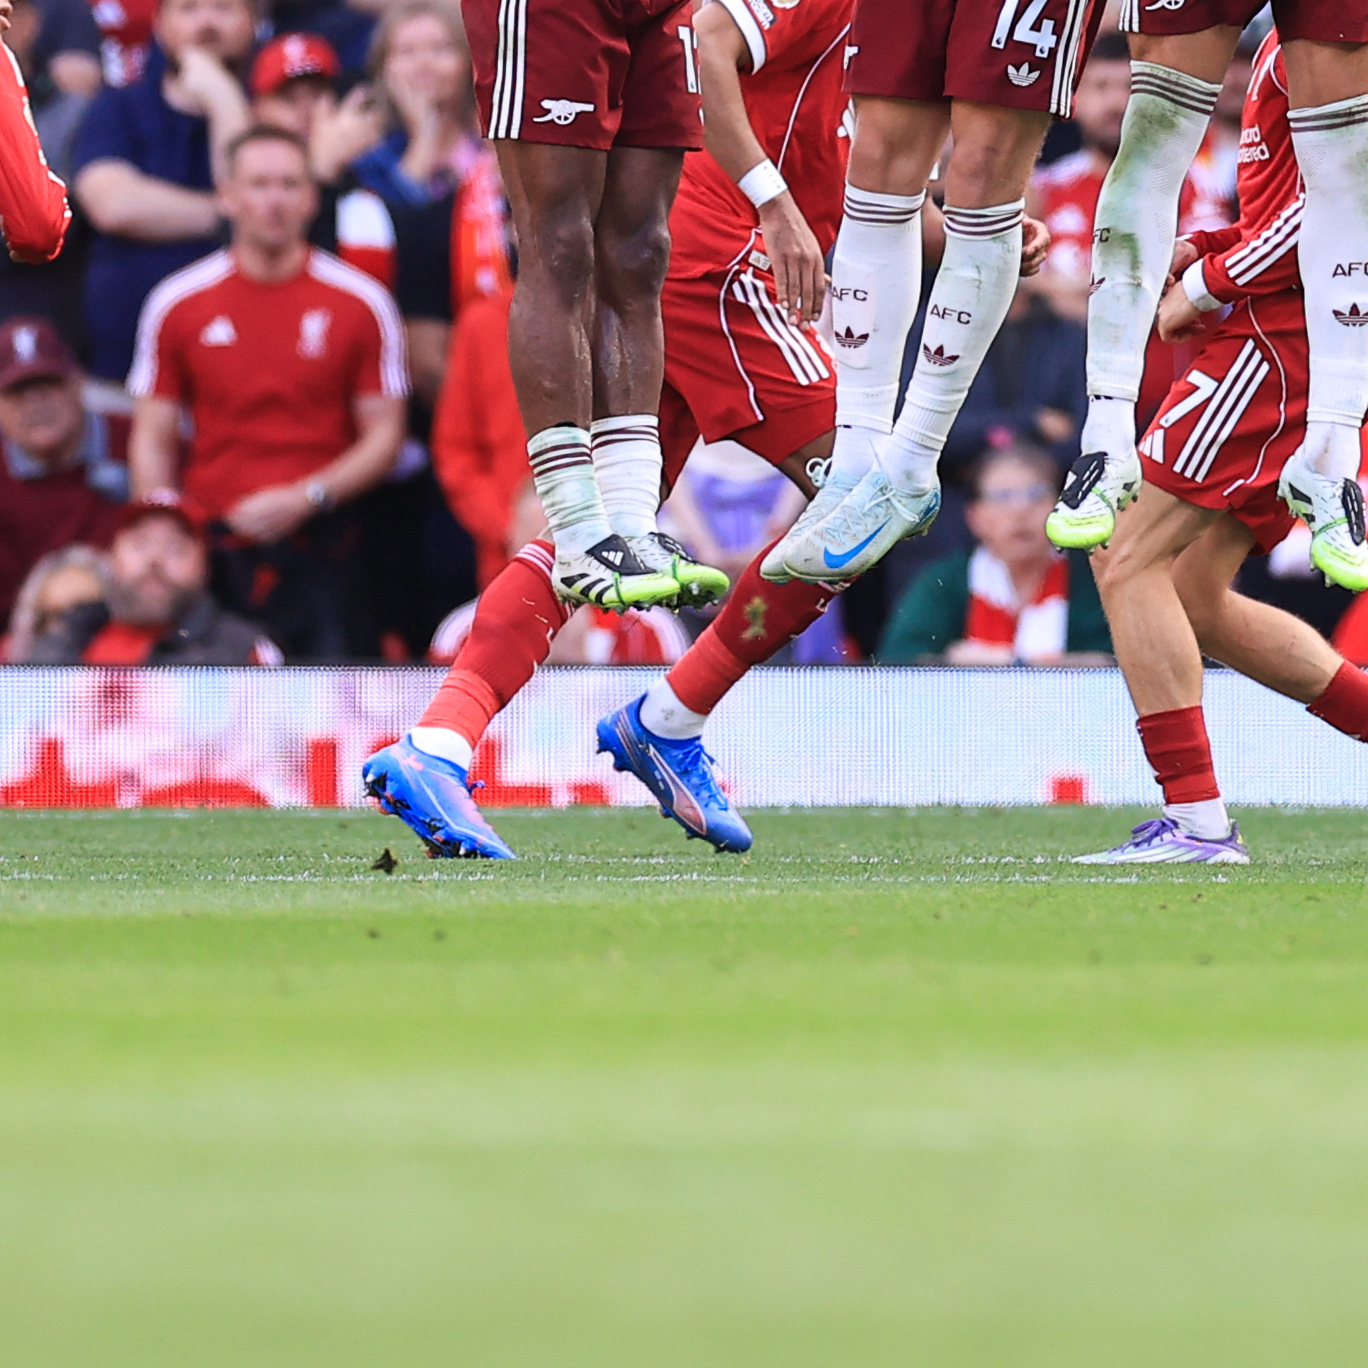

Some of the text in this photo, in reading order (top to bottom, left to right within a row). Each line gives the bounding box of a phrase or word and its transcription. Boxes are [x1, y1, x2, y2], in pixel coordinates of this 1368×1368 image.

[677, 26, 702, 94] 1
[1092, 228, 1110, 244] FC
[832, 286, 868, 302] AFC
[930, 304, 972, 325] AFC
[1159, 369, 1219, 428] 7
